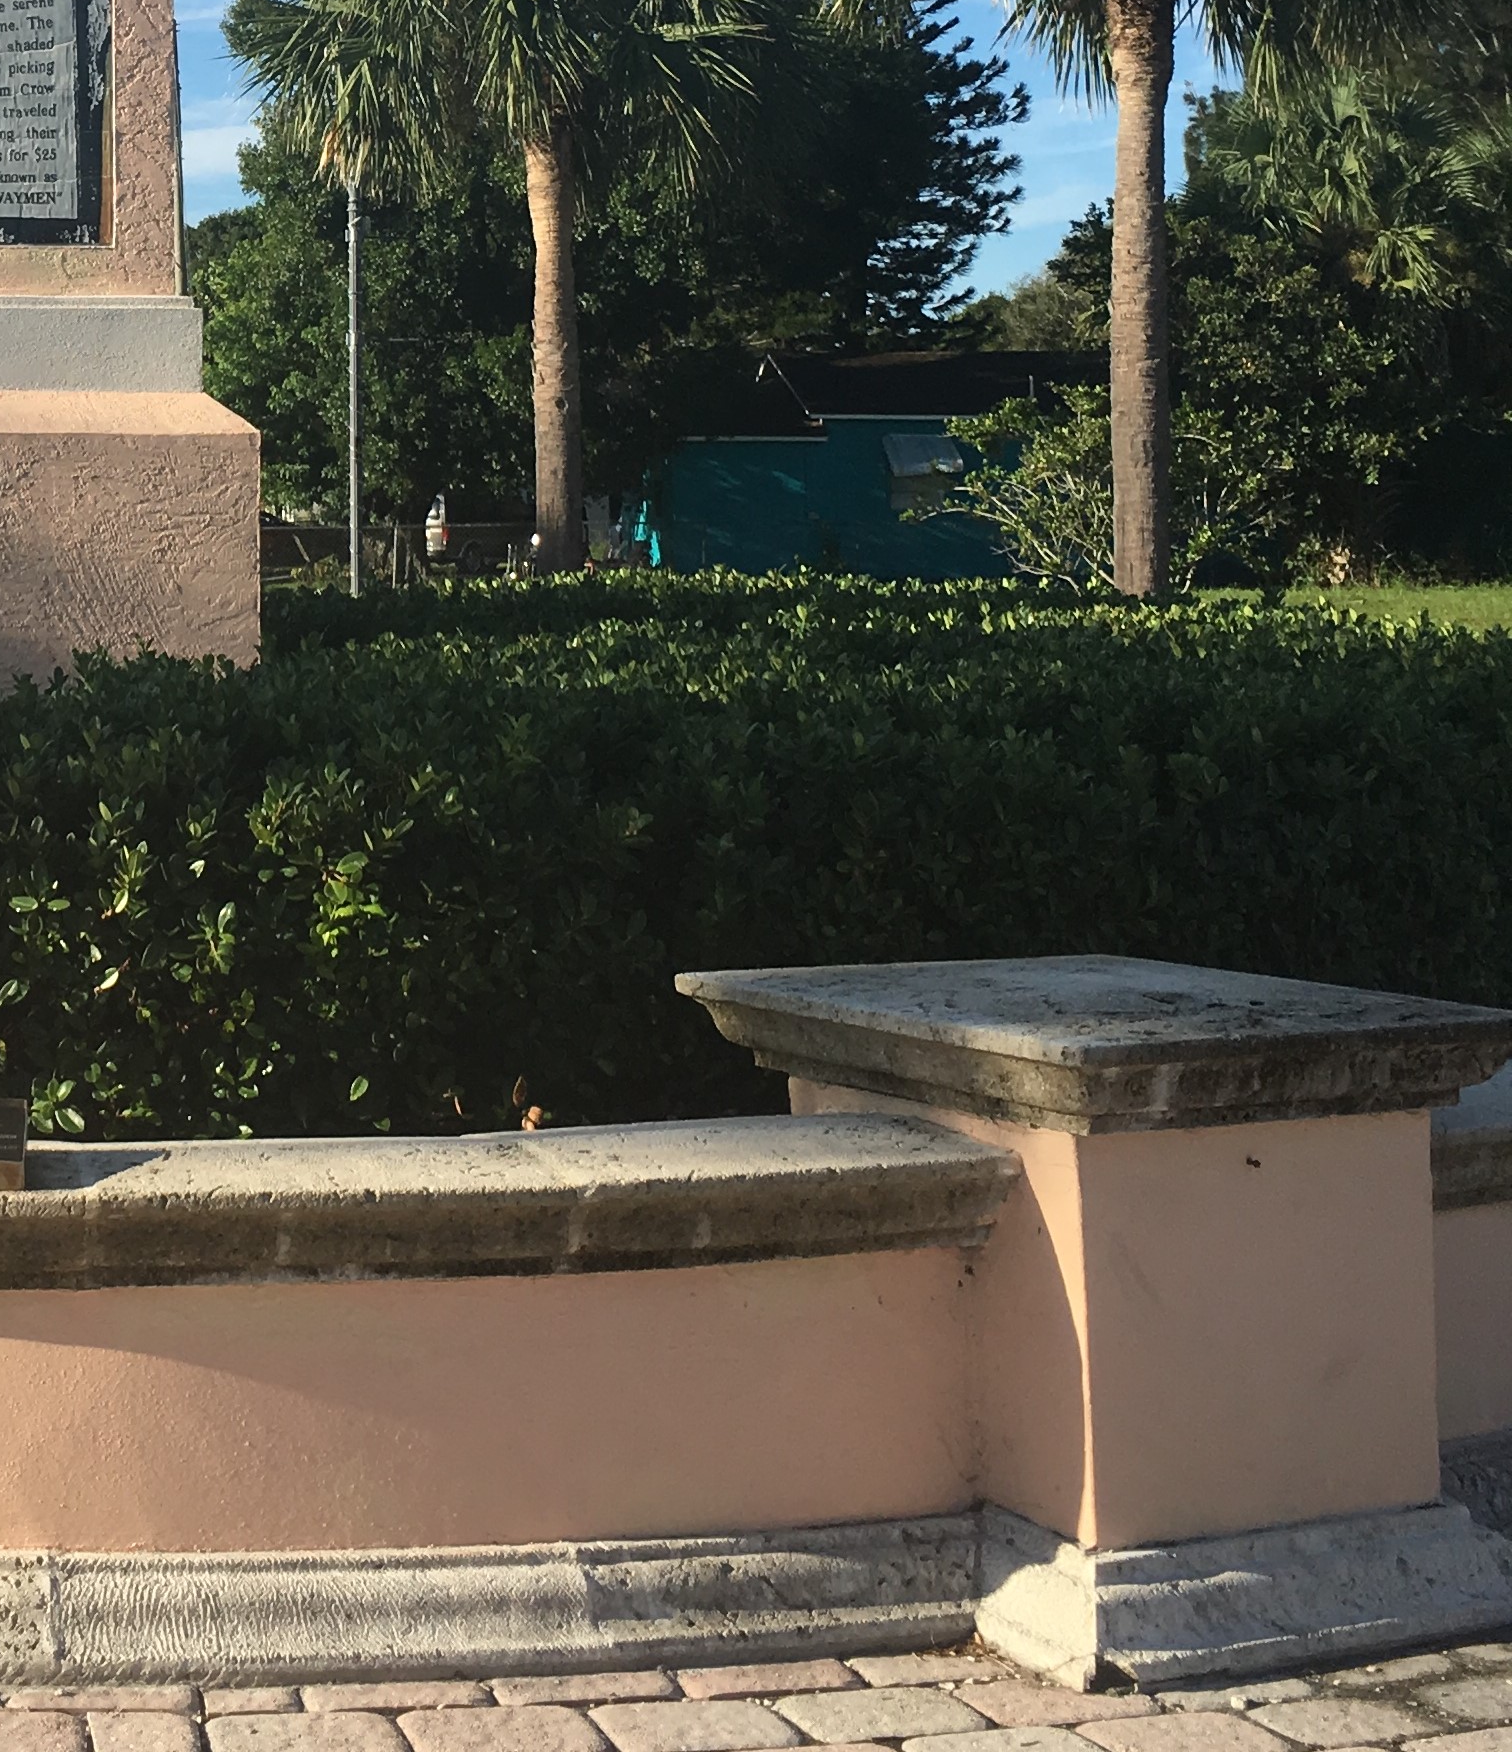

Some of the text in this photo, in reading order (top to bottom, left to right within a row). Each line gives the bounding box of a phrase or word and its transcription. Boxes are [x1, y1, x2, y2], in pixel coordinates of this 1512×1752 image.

[26, 17, 53, 30] The
[7, 38, 54, 52] shaded
[9, 61, 54, 75] picking
[20, 84, 54, 95] Crow
[3, 103, 56, 118] traveled
[26, 127, 56, 139] their
[9, 150, 28, 161] for
[35, 148, 56, 162] $25
[44, 174, 57, 183] as
